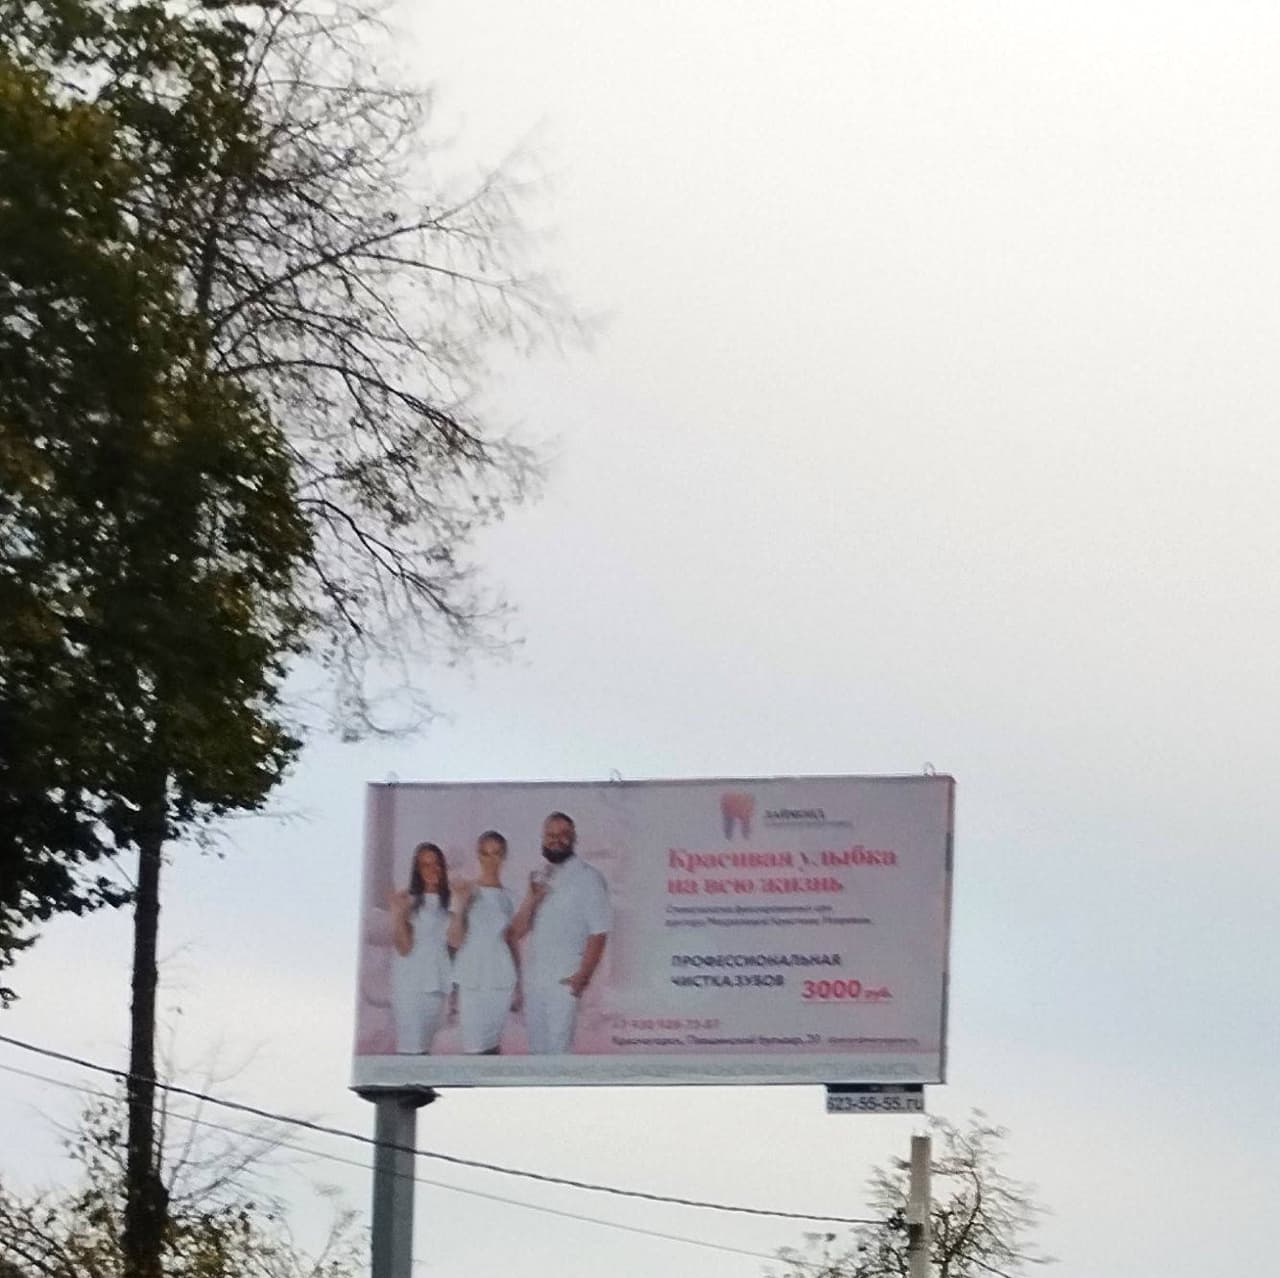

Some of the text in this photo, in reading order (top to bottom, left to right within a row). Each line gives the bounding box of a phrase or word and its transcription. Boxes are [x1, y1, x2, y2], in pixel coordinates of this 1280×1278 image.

[669, 848, 794, 872] Красивая
[667, 877, 844, 894] на всю жизнь
[671, 954, 841, 967] ПРОФЕССИОНАЛЬНАЯ
[671, 974, 785, 988] ЧИСТКА ЗУБОВ
[801, 979, 862, 999] 3000
